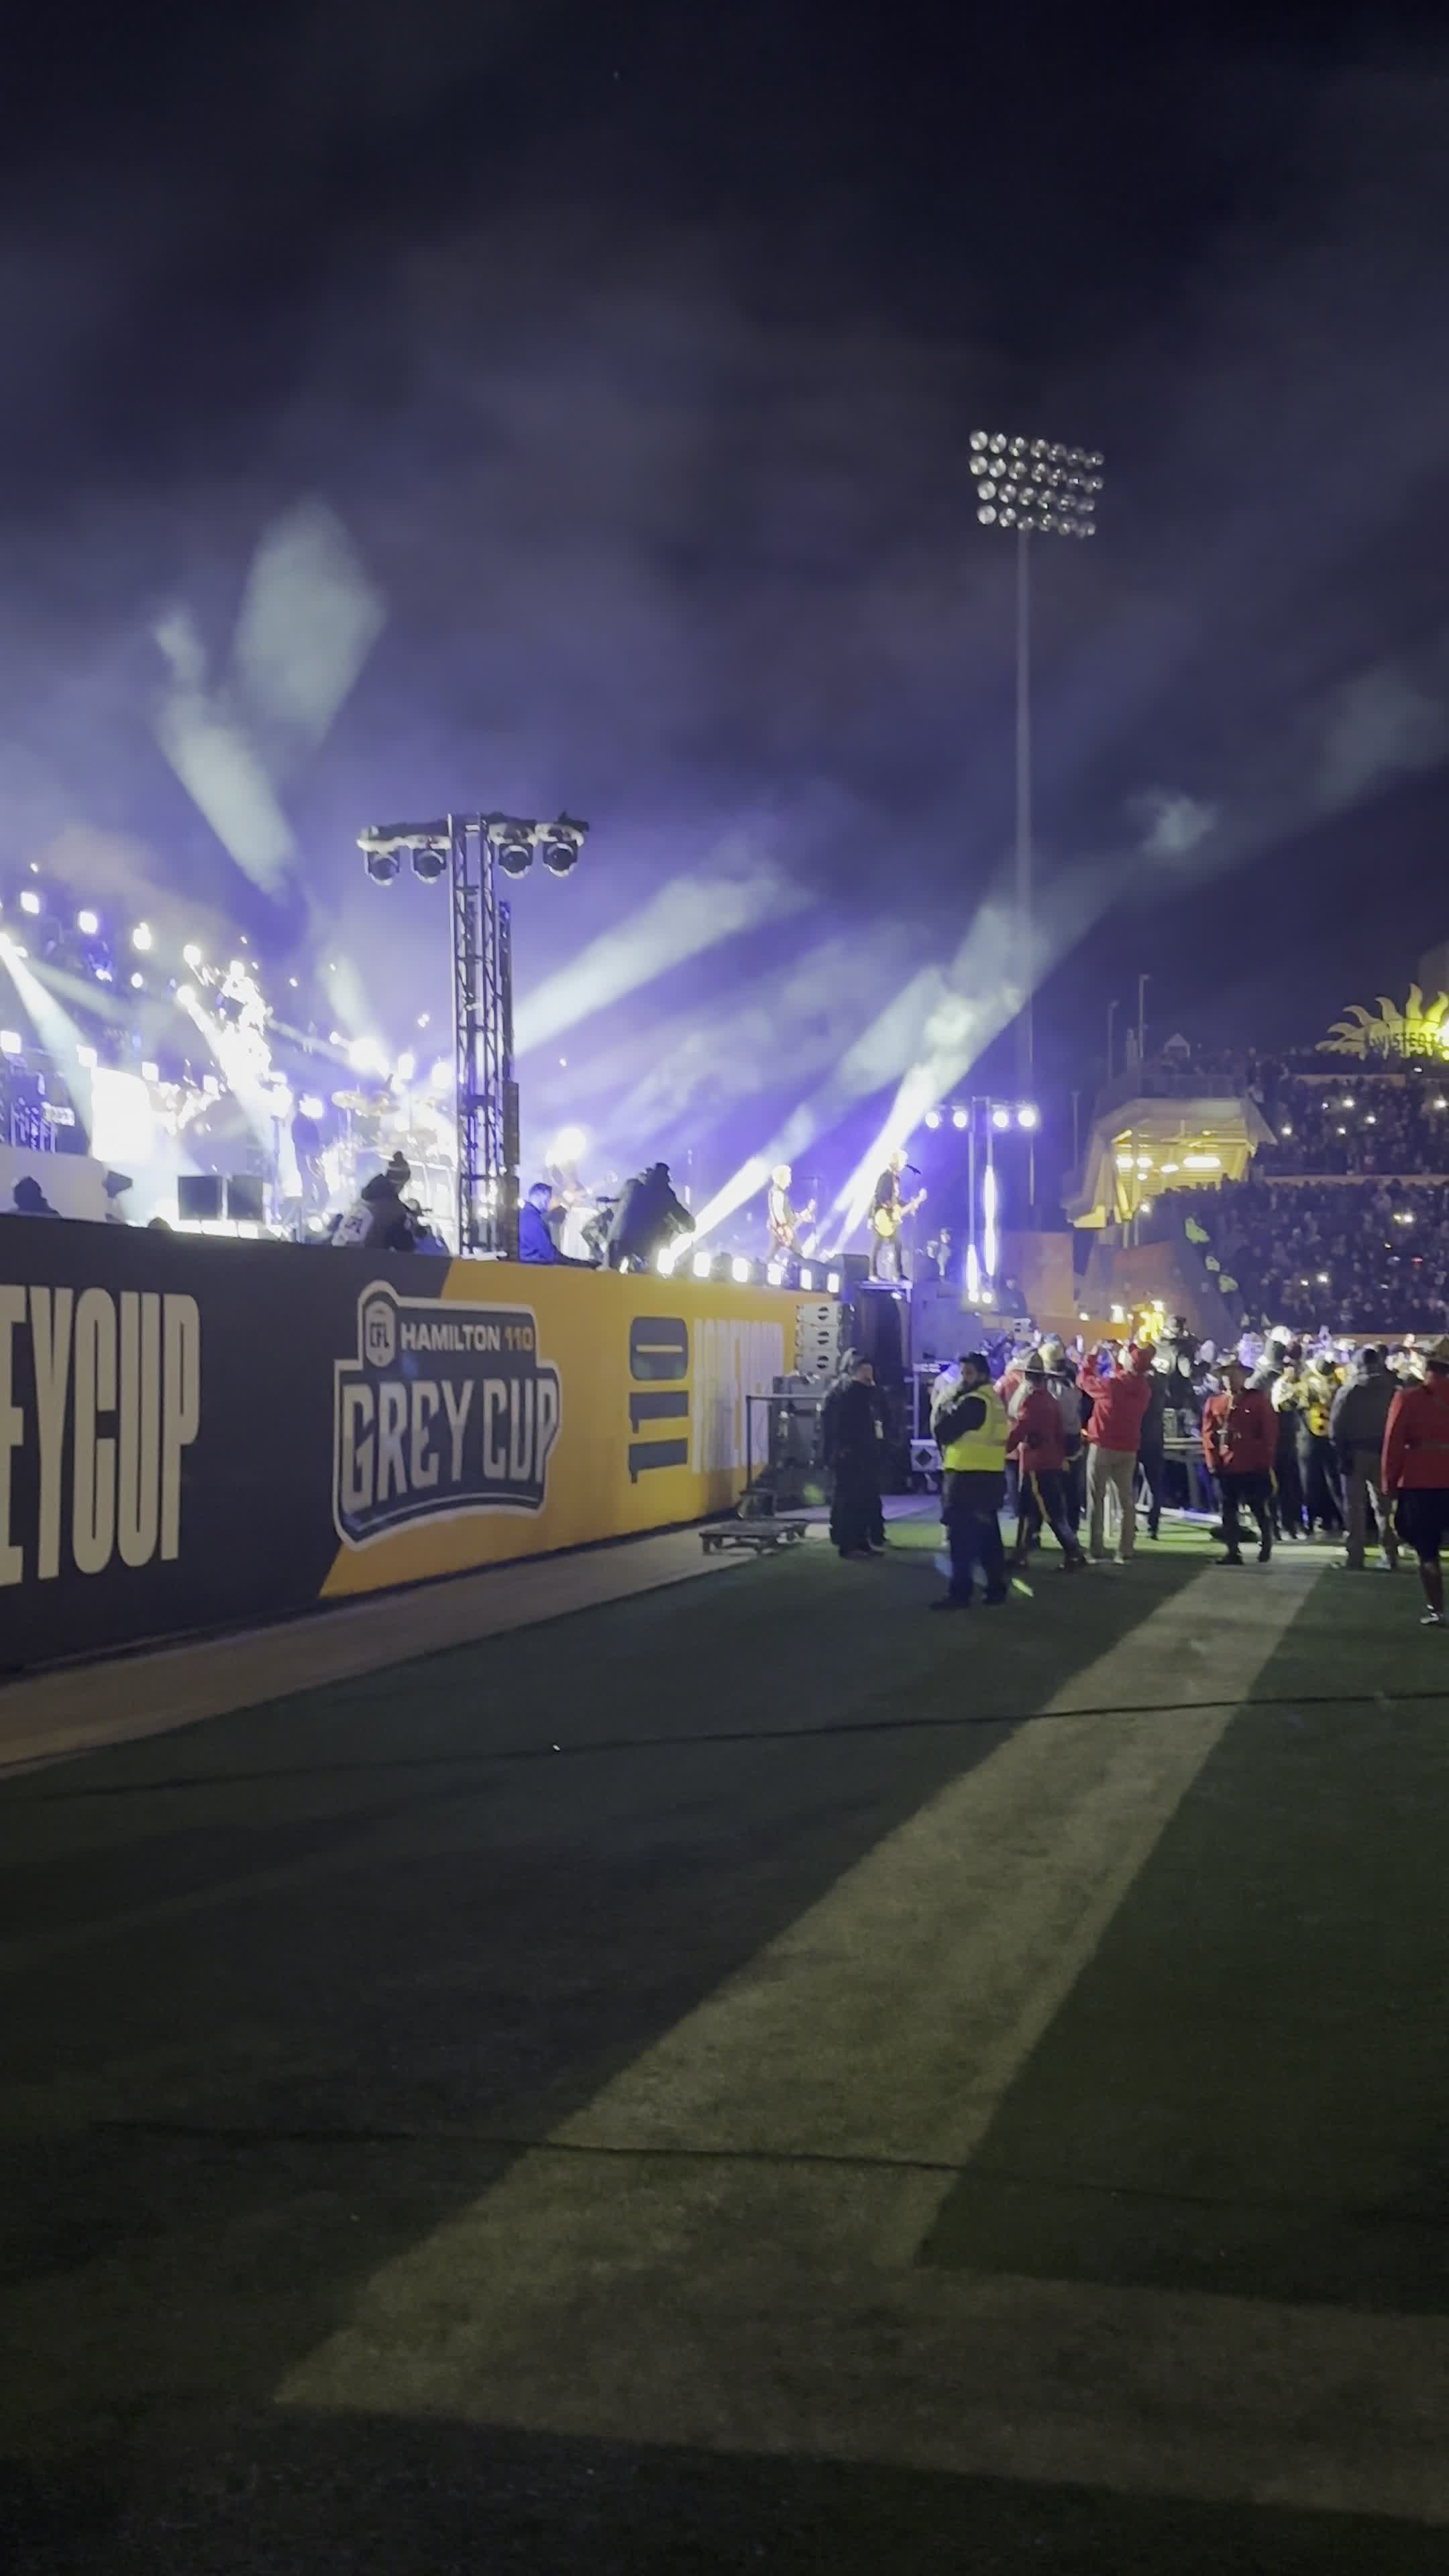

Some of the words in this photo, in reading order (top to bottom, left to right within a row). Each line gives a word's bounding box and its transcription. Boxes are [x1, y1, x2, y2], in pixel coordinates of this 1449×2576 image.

[400, 1322, 500, 1352] HAMILTON
[504, 1326, 535, 1352] 110
[341, 1379, 474, 1515] GREY
[482, 1378, 558, 1483] CUP
